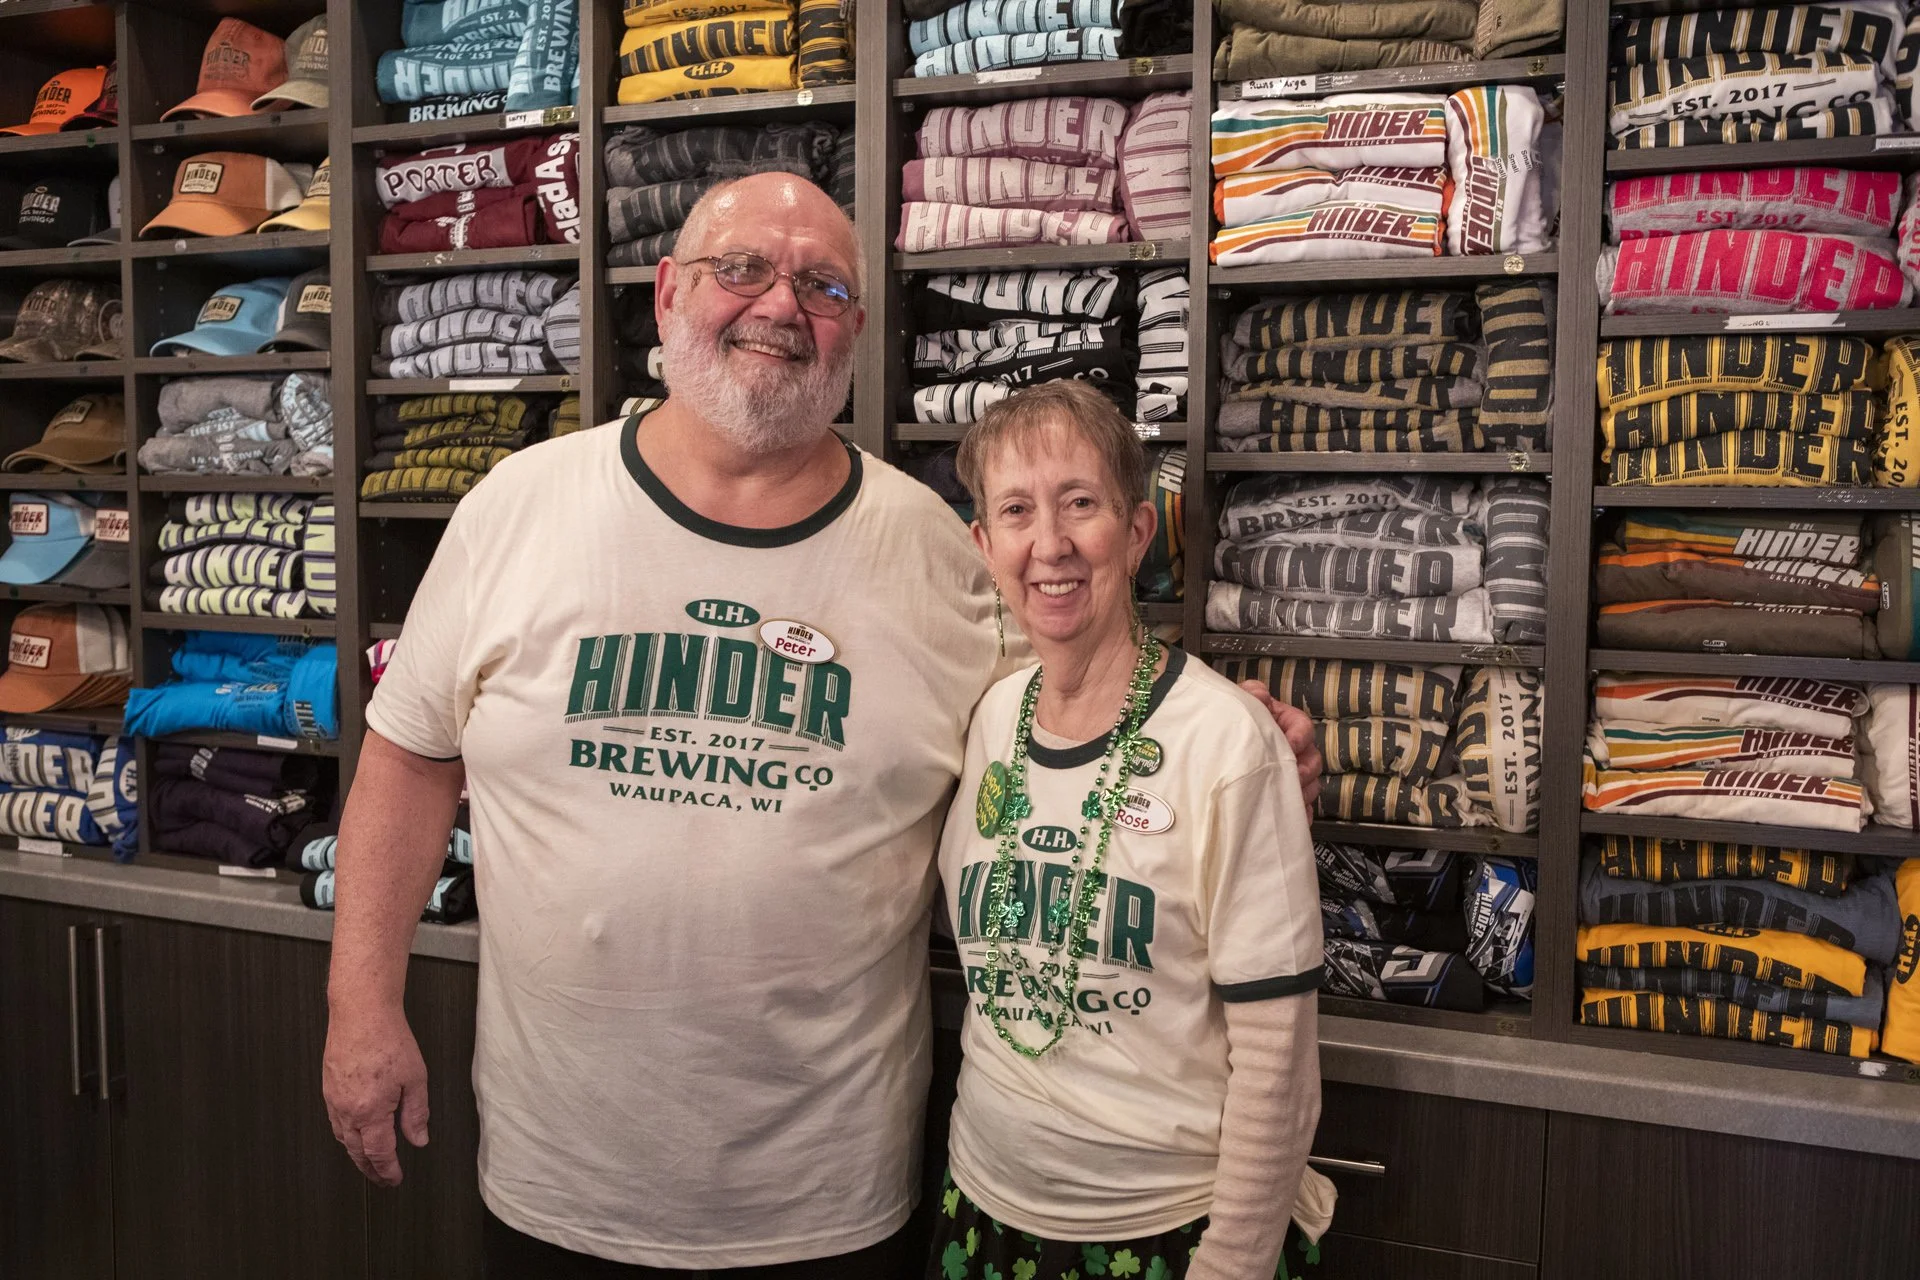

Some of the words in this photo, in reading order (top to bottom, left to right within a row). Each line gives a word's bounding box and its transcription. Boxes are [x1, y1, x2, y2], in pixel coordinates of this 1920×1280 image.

[480, 12, 503, 25] EST.
[541, 0, 552, 20] 20
[1608, 5, 1893, 67] HINDER
[914, 26, 1124, 78] HINDER
[394, 57, 515, 100] INDER
[690, 60, 729, 78] H.H.
[409, 95, 500, 123] BREWING
[1671, 95, 1719, 117] EST.
[1729, 83, 1788, 105] 2017
[919, 96, 1130, 166] HINDER
[1322, 109, 1431, 140] HINDER
[383, 152, 499, 197] PORTER
[1494, 157, 1507, 178] Small
[1507, 153, 1520, 174] Small
[1520, 149, 1533, 171] Small
[1612, 167, 1903, 229] HINDER
[1306, 207, 1419, 239] HINDER
[1695, 209, 1740, 224] EST.
[1752, 213, 1807, 226] 2017
[1610, 229, 1906, 312] HINDER
[1604, 335, 1870, 405] HINDER
[1893, 401, 1910, 448] EST.
[1297, 494, 1338, 508] EST.
[1344, 493, 1391, 506] 2017
[1733, 527, 1861, 565] HINDER
[1222, 549, 1453, 598] HINDER
[698, 601, 750, 624] H.H.
[775, 637, 816, 657] Peter
[787, 626, 815, 642] HINDER
[564, 632, 851, 752] HINDER
[1498, 692, 1516, 741] 2017
[651, 727, 697, 745] EST.
[708, 733, 765, 752] 2017
[1740, 728, 1856, 754] HINDER
[569, 738, 788, 790] BREWING
[1504, 751, 1519, 795] EST.
[609, 782, 742, 812] WAUPACA,
[751, 797, 783, 814] WI
[1702, 769, 1833, 796] HINDER
[1126, 795, 1151, 810] HINDER
[1115, 808, 1150, 830] Rose
[1031, 828, 1072, 850] H.H.
[1473, 893, 1493, 939] HINDER
